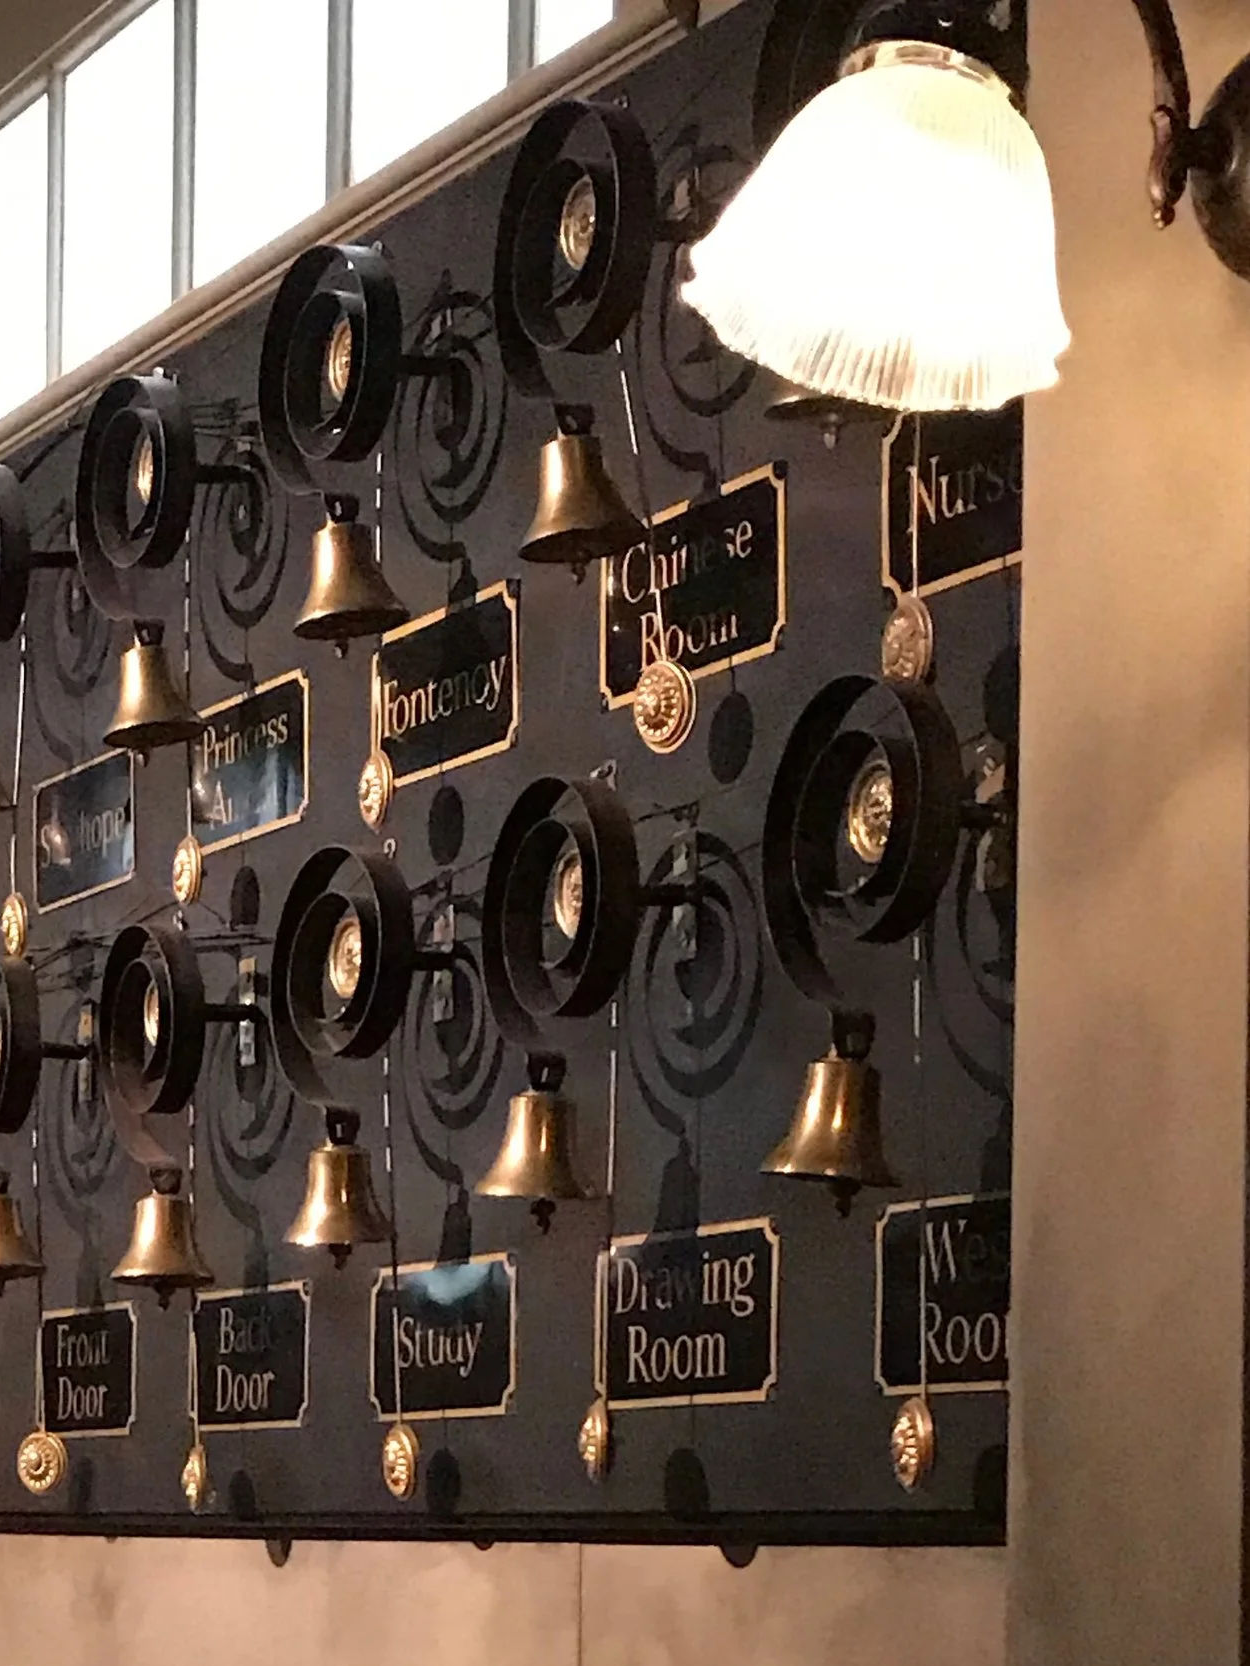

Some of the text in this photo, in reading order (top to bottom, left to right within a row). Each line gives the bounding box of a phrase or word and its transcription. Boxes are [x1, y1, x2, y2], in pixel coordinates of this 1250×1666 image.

[639, 611, 739, 672] Room
[382, 655, 508, 740] Fontenoy
[202, 712, 289, 774] Princess
[56, 1323, 110, 1368] Front
[219, 1306, 273, 1355] Back
[398, 1314, 484, 1378] Study
[626, 1324, 728, 1384] Room
[920, 1301, 1009, 1364] Roo
[56, 1375, 110, 1421] Door
[216, 1363, 276, 1413] Door
